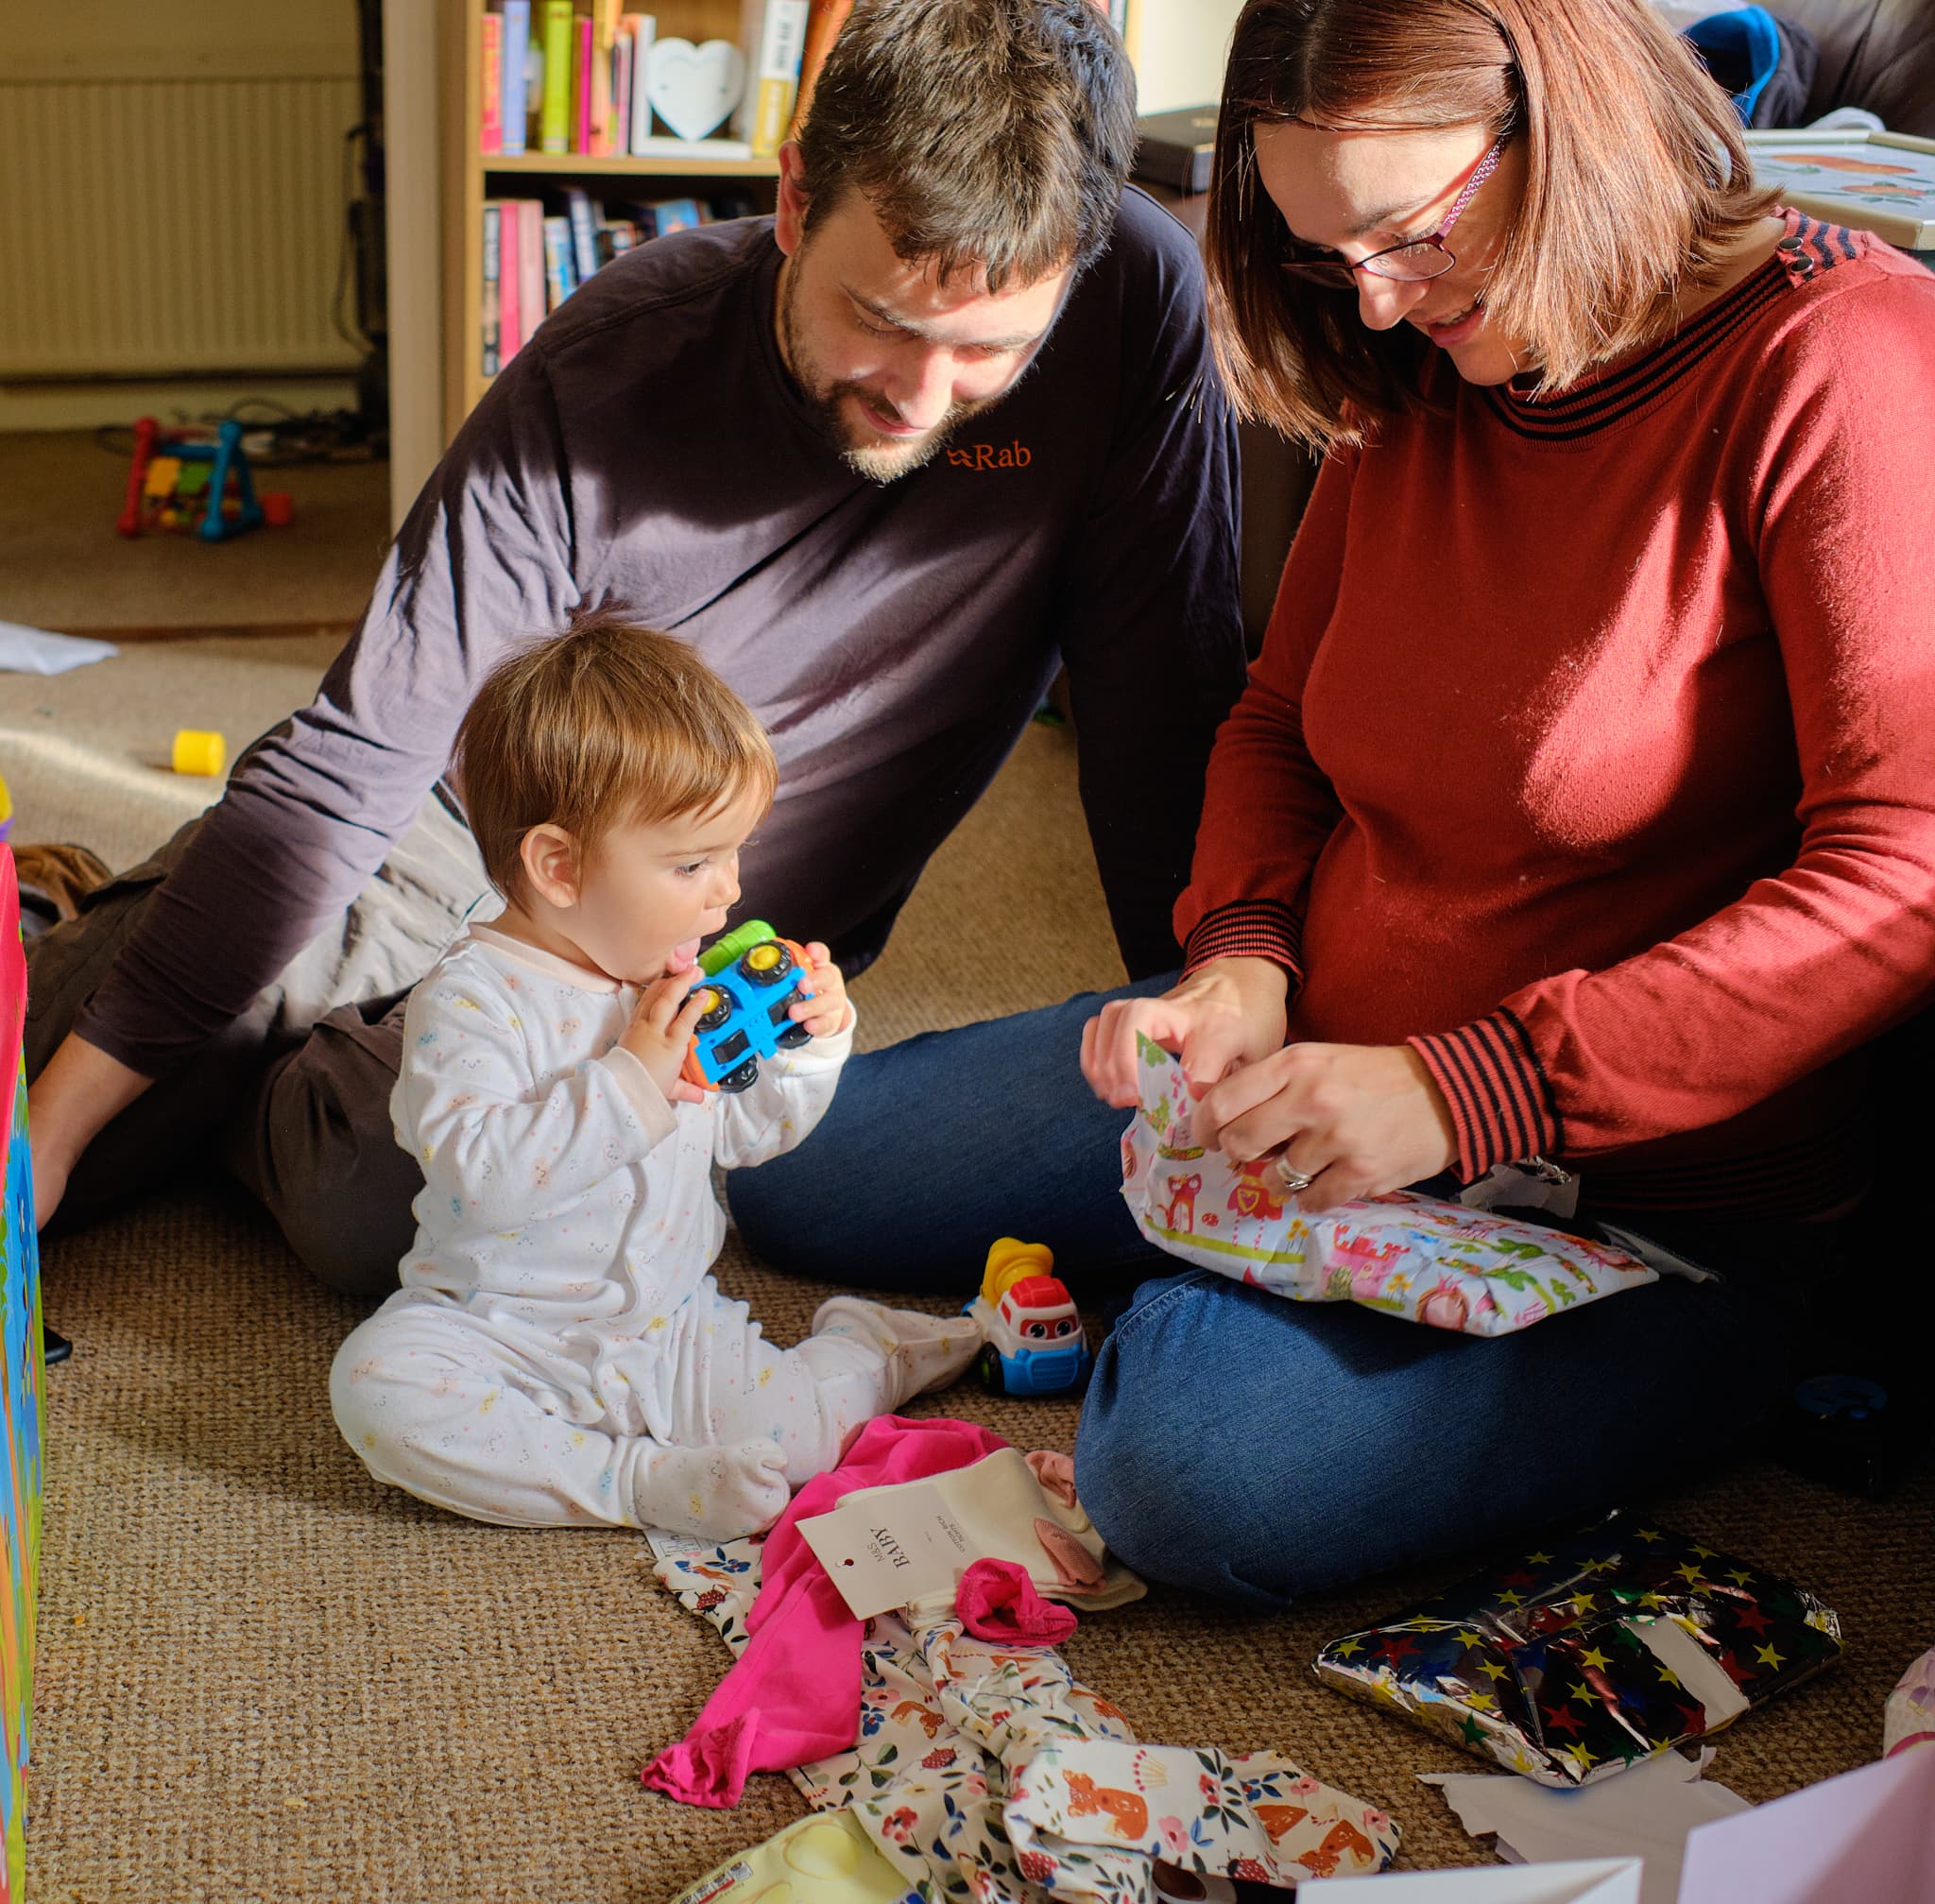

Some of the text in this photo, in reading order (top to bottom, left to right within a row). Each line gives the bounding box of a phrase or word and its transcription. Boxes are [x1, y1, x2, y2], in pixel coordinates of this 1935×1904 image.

[972, 439, 1032, 472] Rab
[867, 1542, 885, 1562] M&S
[869, 1528, 911, 1569] BABY
[946, 1530, 966, 1552] COTTON
